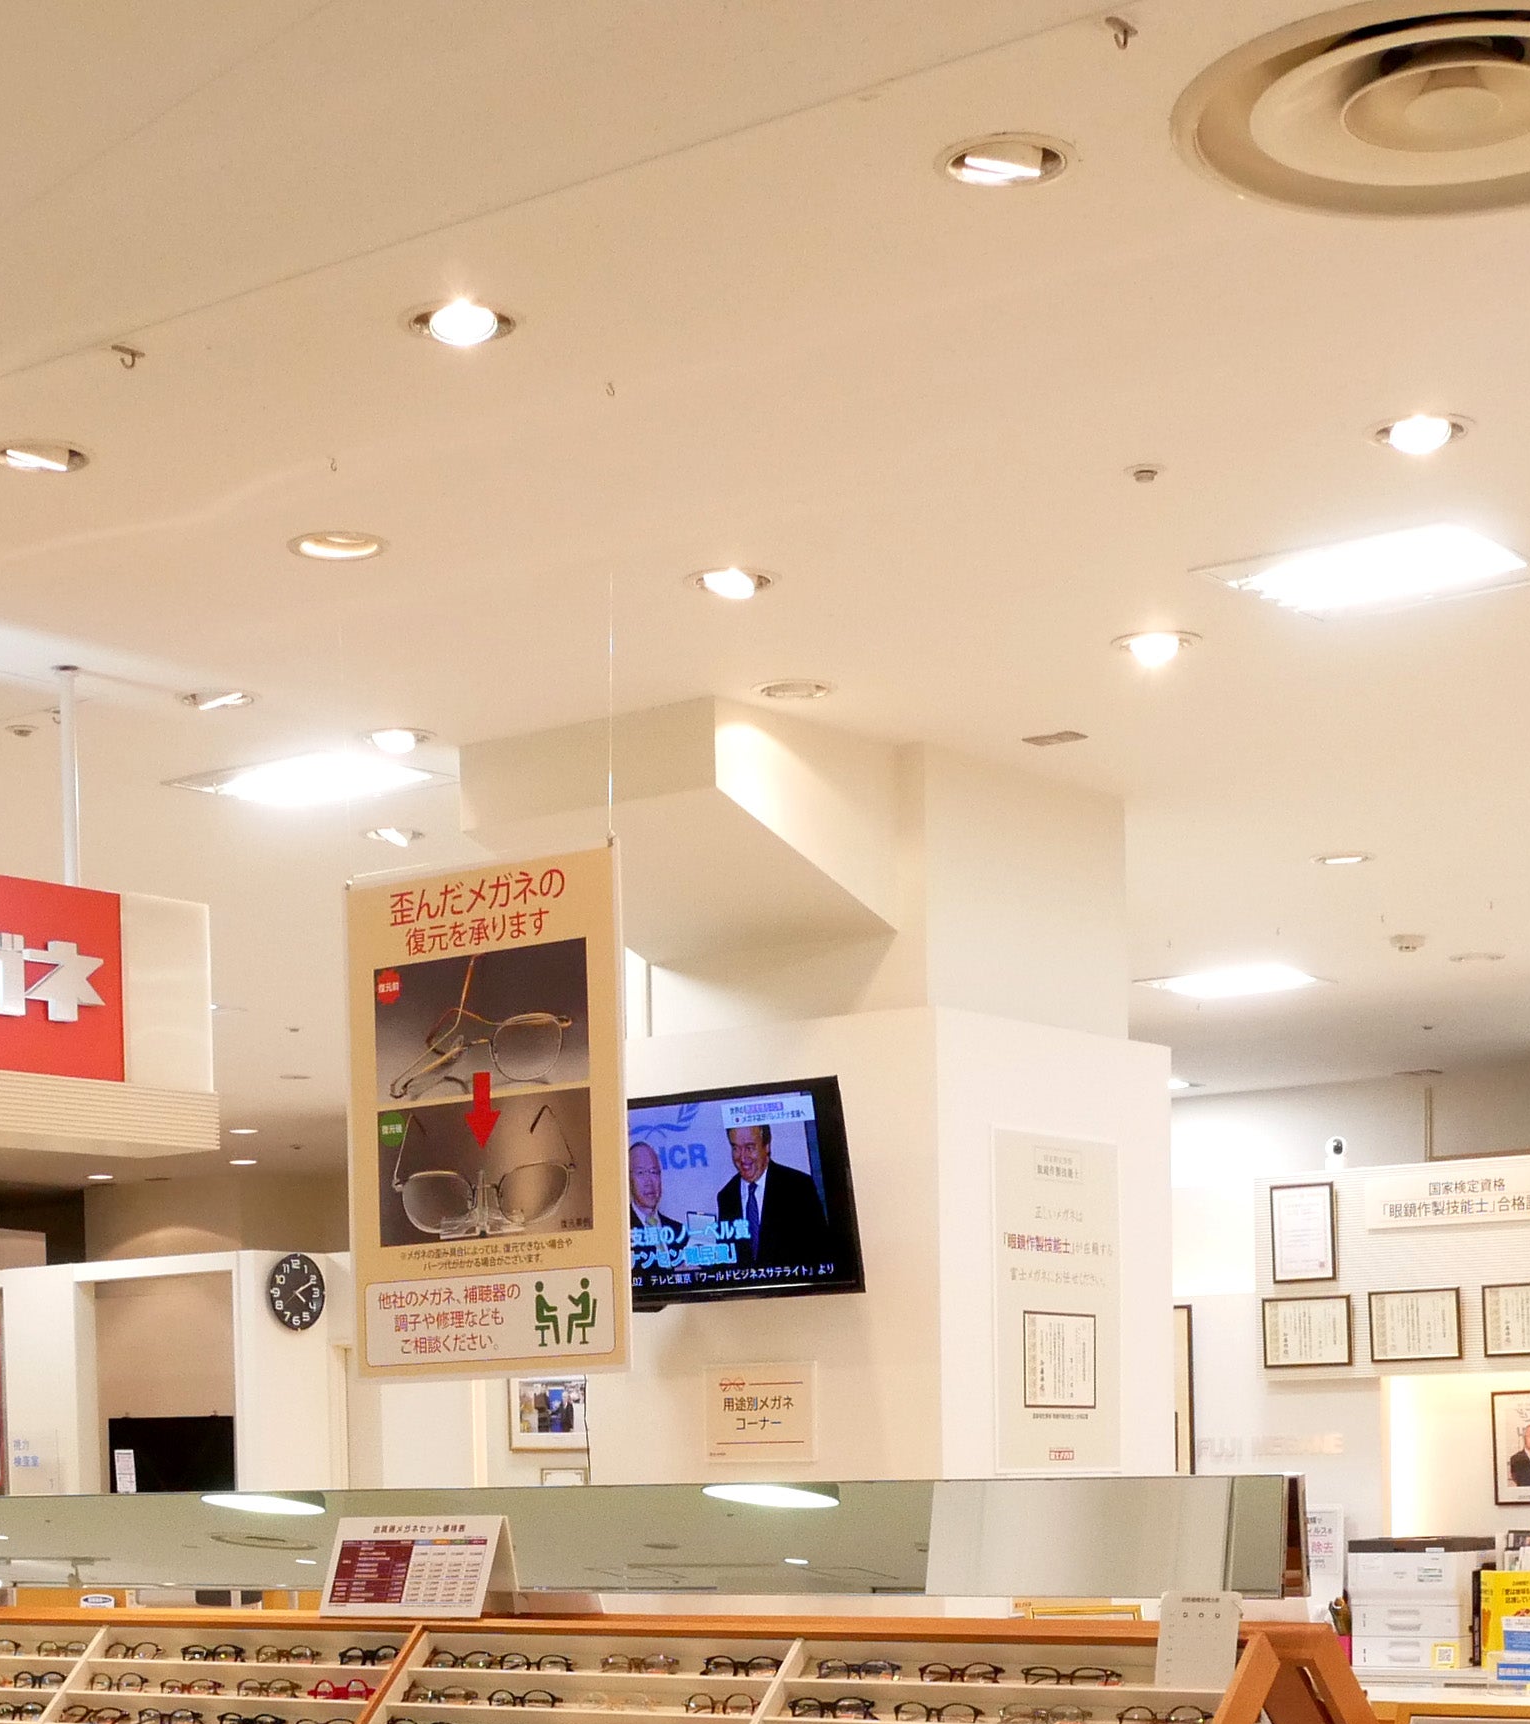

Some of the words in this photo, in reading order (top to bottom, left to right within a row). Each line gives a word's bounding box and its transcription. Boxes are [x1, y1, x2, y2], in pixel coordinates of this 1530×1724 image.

[389, 867, 566, 927] 歪んだメガネの
[405, 907, 550, 957] 復元を承ります
[1428, 1177, 1506, 1197] 国家検定資格
[282, 1264, 290, 1274] 11
[290, 1258, 301, 1270] 12
[303, 1264, 308, 1274] 1
[275, 1274, 286, 1285] 10
[309, 1274, 317, 1284] 2
[272, 1287, 281, 1298] 9
[312, 1287, 320, 1298] 3
[377, 1283, 521, 1311] 他社のメガネ、補聴器の
[275, 1300, 284, 1311] 8
[308, 1301, 316, 1312] 4
[283, 1311, 291, 1322] 7
[292, 1315, 301, 1326] 6
[302, 1311, 310, 1322] 5
[393, 1307, 505, 1333] 調子や修理なども
[399, 1332, 500, 1355] ご相談ください。
[723, 1395, 794, 1412] 用途別メガネ
[735, 1416, 782, 1431] コーナー
